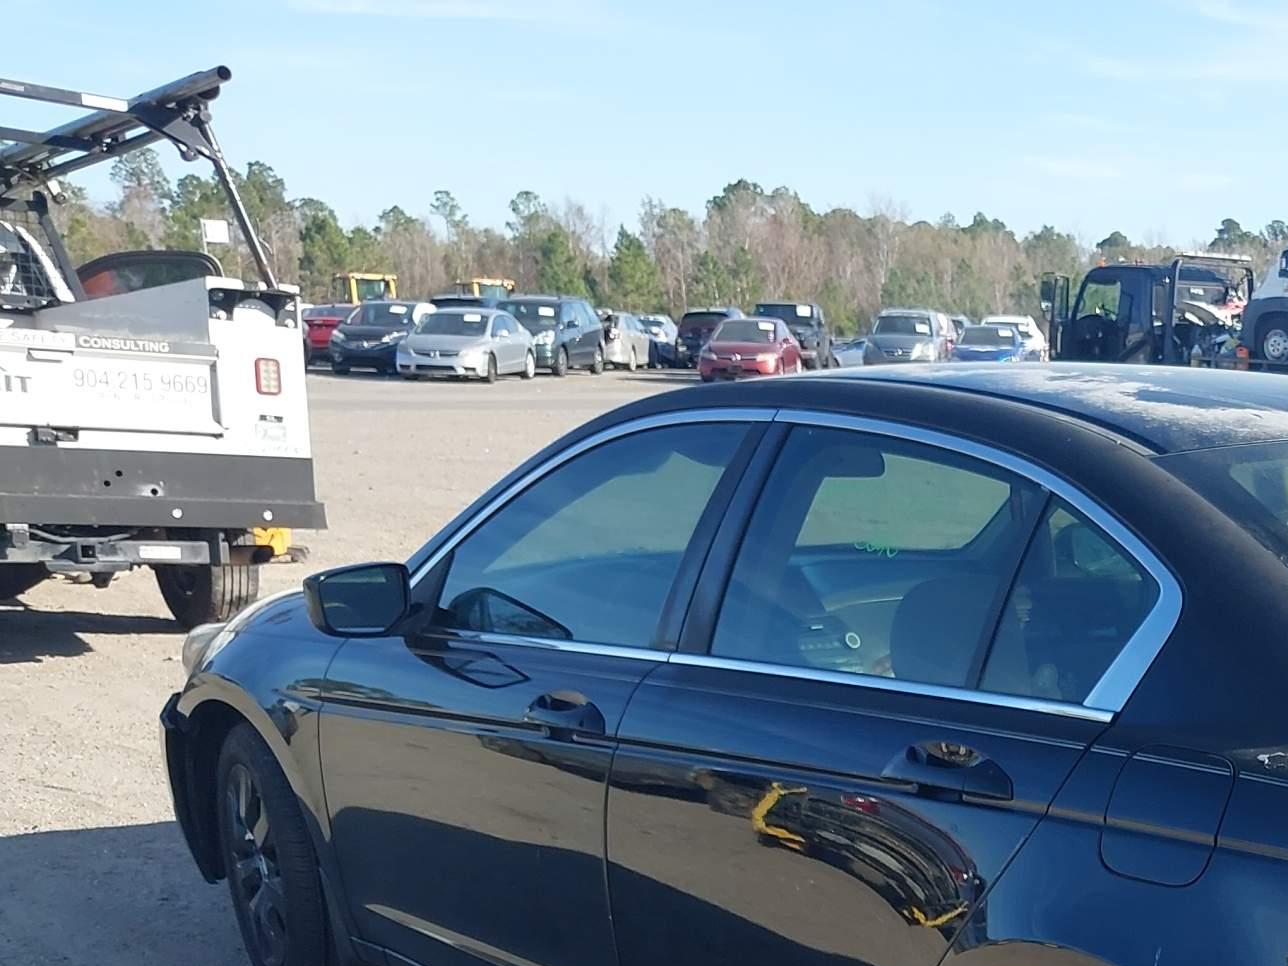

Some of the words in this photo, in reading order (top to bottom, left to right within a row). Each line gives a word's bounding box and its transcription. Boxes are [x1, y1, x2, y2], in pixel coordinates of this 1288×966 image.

[79, 336, 170, 353] CONSULTING
[0, 374, 32, 393] IT
[73, 368, 109, 389] 904
[117, 371, 153, 393] 215
[160, 374, 208, 394] 9669
